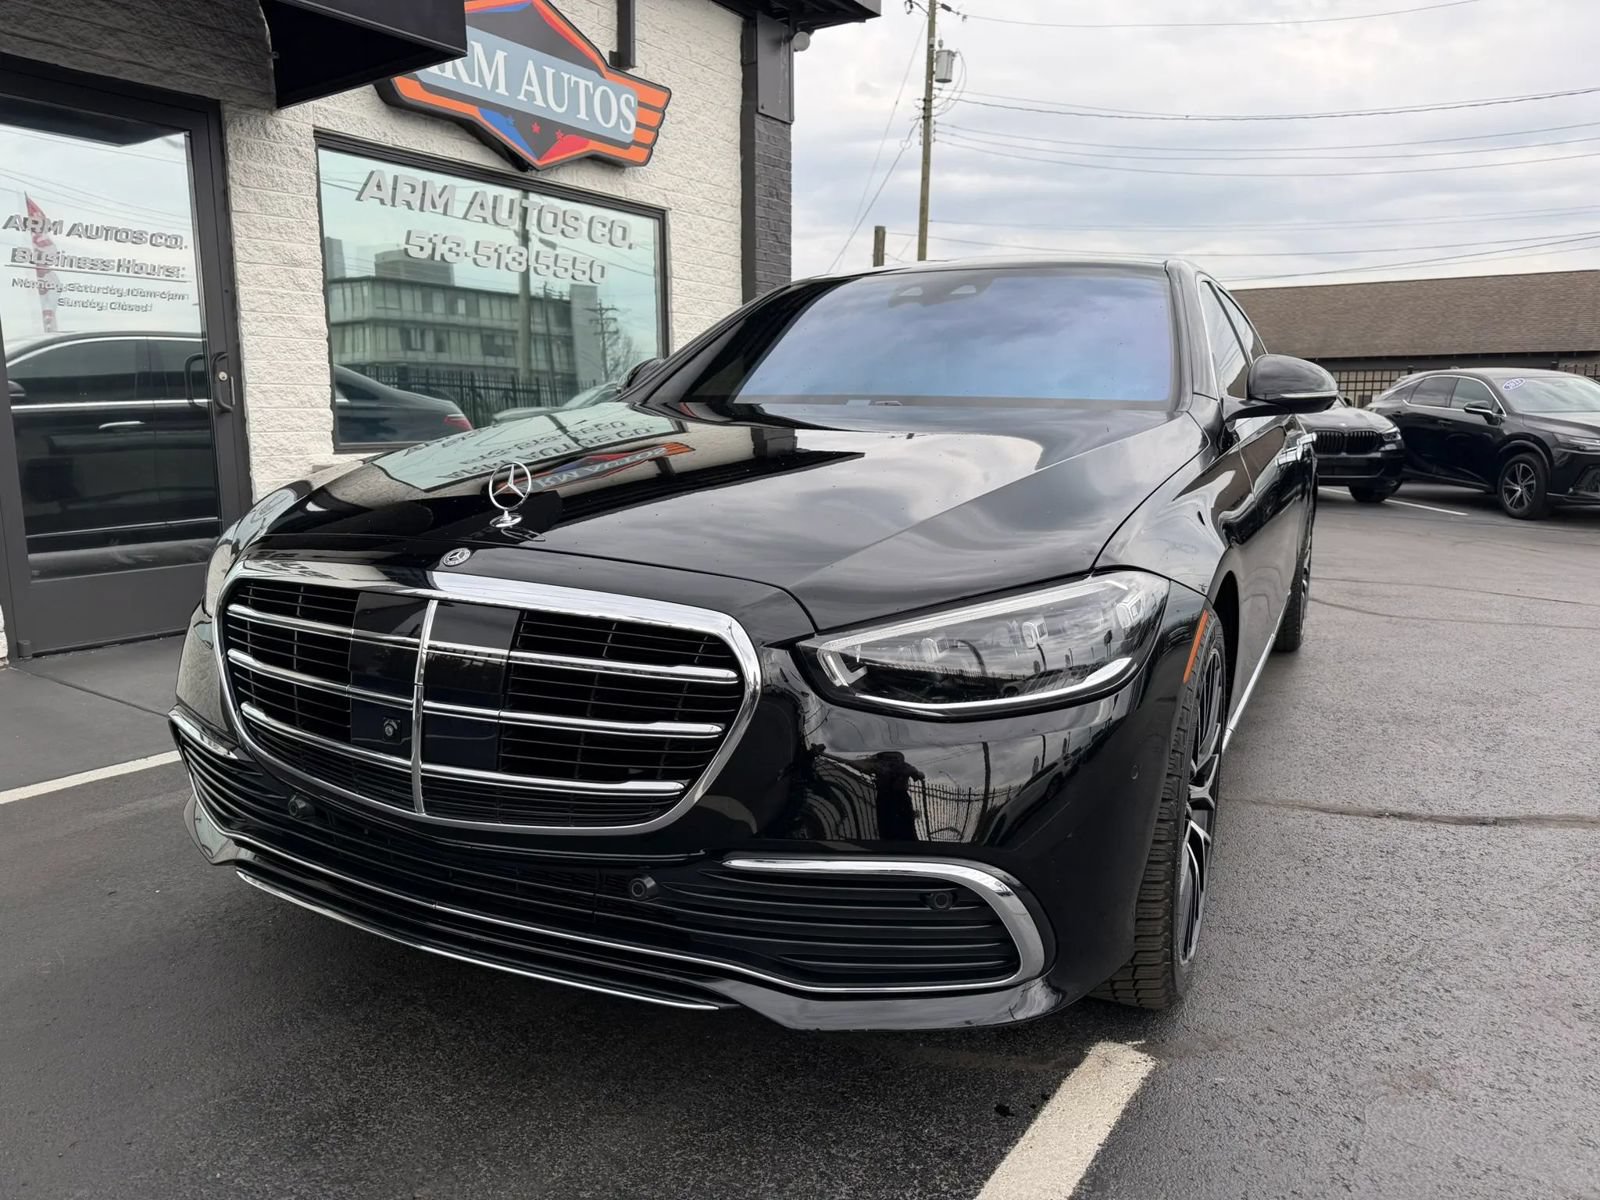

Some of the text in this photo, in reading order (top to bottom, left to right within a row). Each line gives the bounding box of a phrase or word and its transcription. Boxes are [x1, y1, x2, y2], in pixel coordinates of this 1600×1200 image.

[425, 41, 637, 135] RM AUTOS
[356, 169, 457, 216] ARM
[462, 190, 583, 239] AUTOS
[2, 214, 64, 236] ARM
[66, 221, 148, 245] AUTOS
[11, 247, 116, 272] Business
